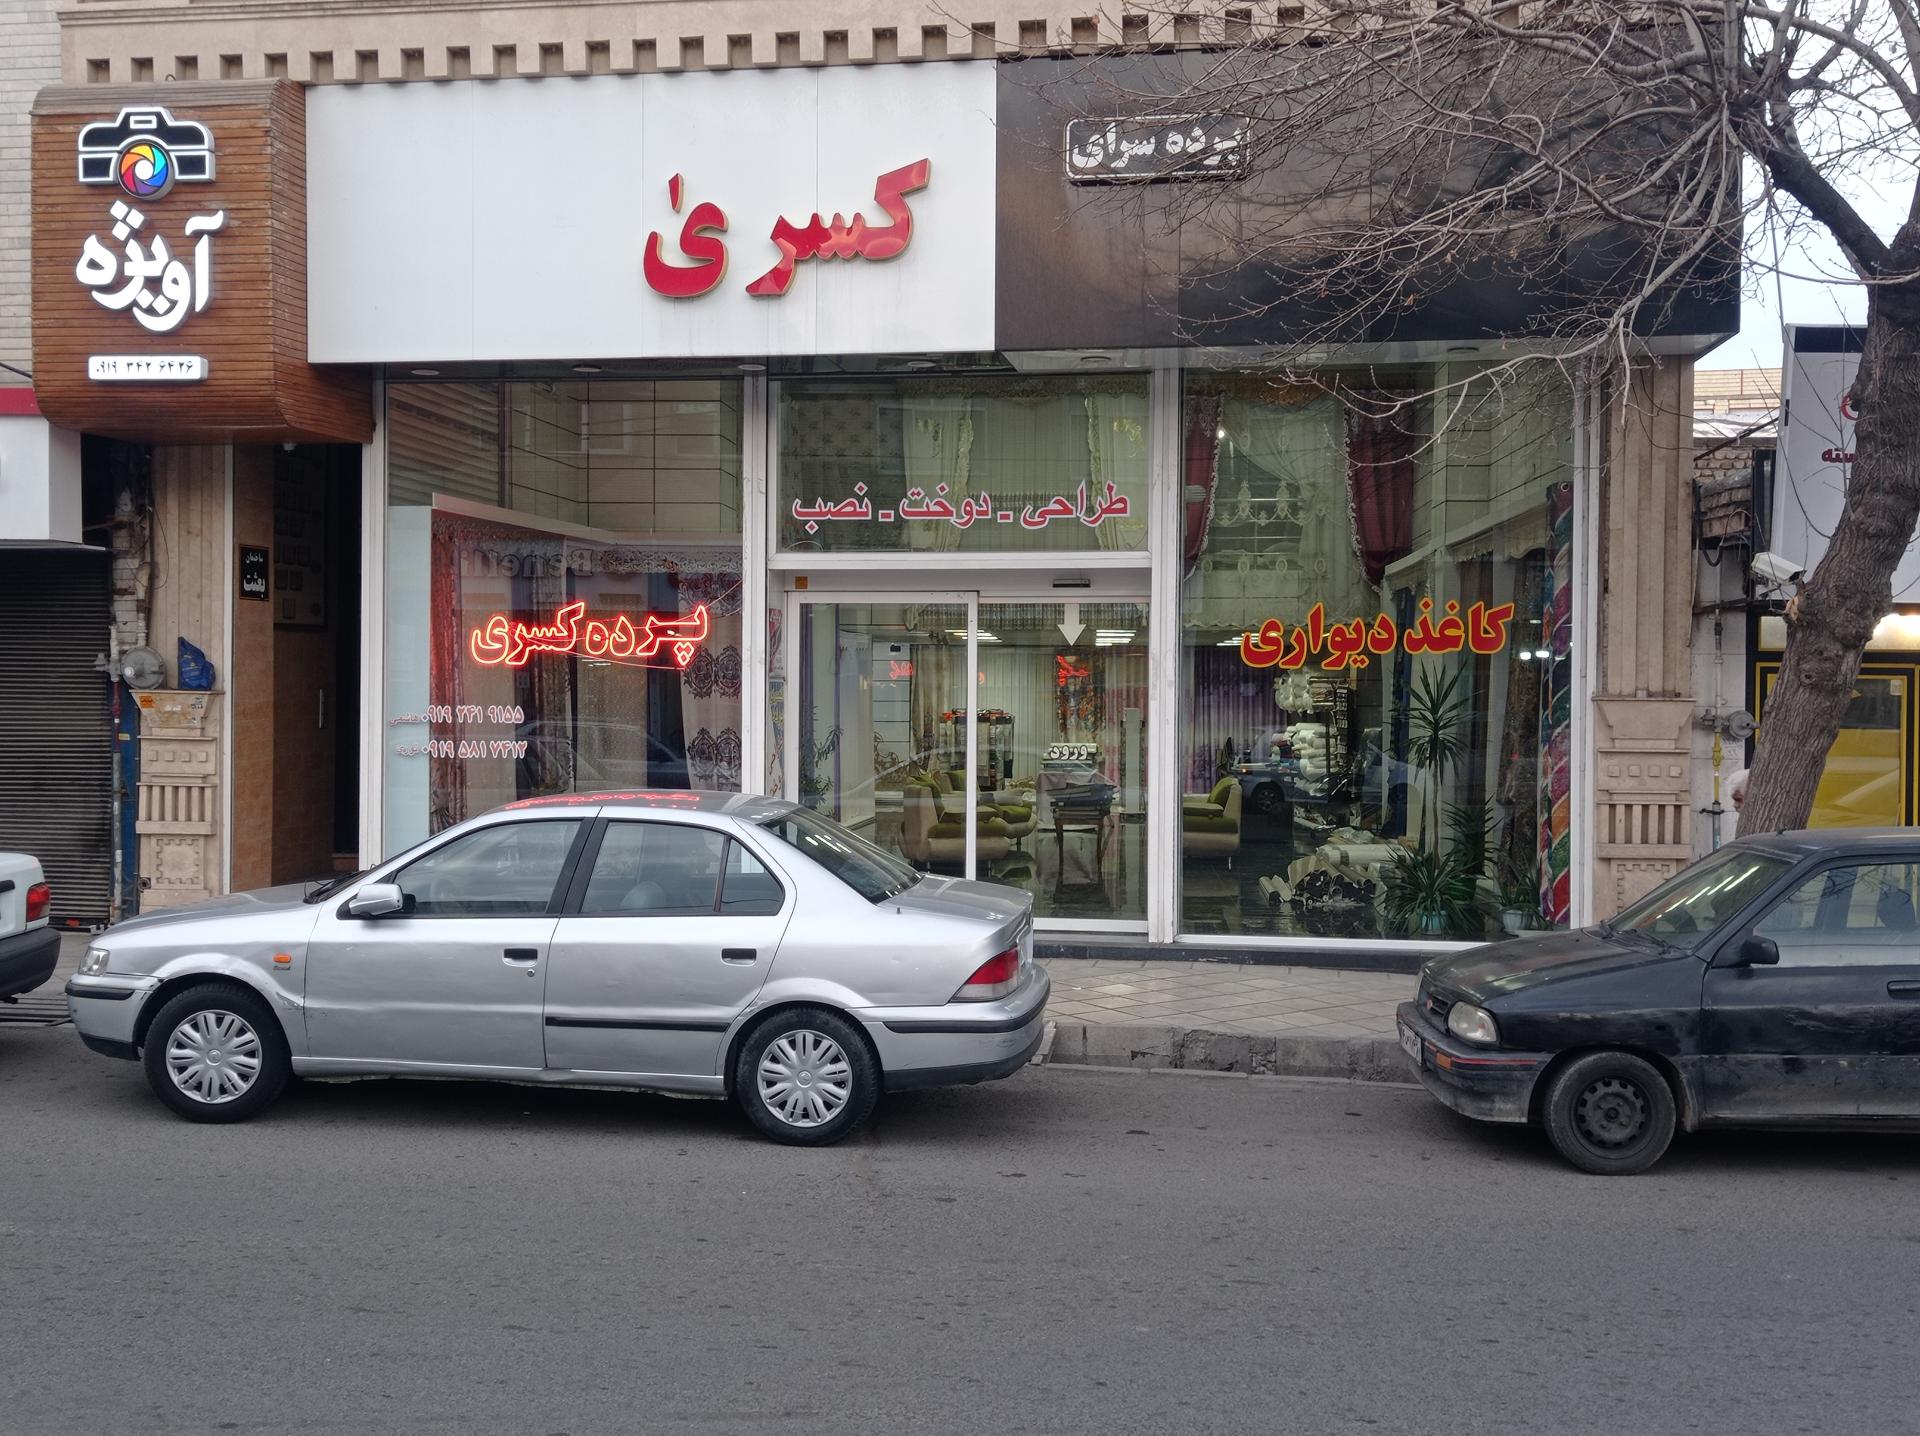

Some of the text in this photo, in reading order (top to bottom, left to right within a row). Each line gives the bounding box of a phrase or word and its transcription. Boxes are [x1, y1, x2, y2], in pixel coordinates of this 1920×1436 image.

[1072, 122, 1243, 168] پرده سرای
[75, 199, 225, 332] آویژه
[96, 360, 118, 374] ۰۹۱۹
[792, 480, 872, 535] نصب
[899, 482, 992, 530] دوخت
[1019, 479, 1131, 530] طراحی
[471, 601, 708, 666] پرده کسری
[1240, 597, 1515, 669] کاغذ دیواری
[420, 704, 453, 724] ۰۹۱۹
[421, 739, 455, 759] ۰۹۱۹
[457, 739, 487, 759] ۵۸۱
[1049, 744, 1089, 761] ورود
